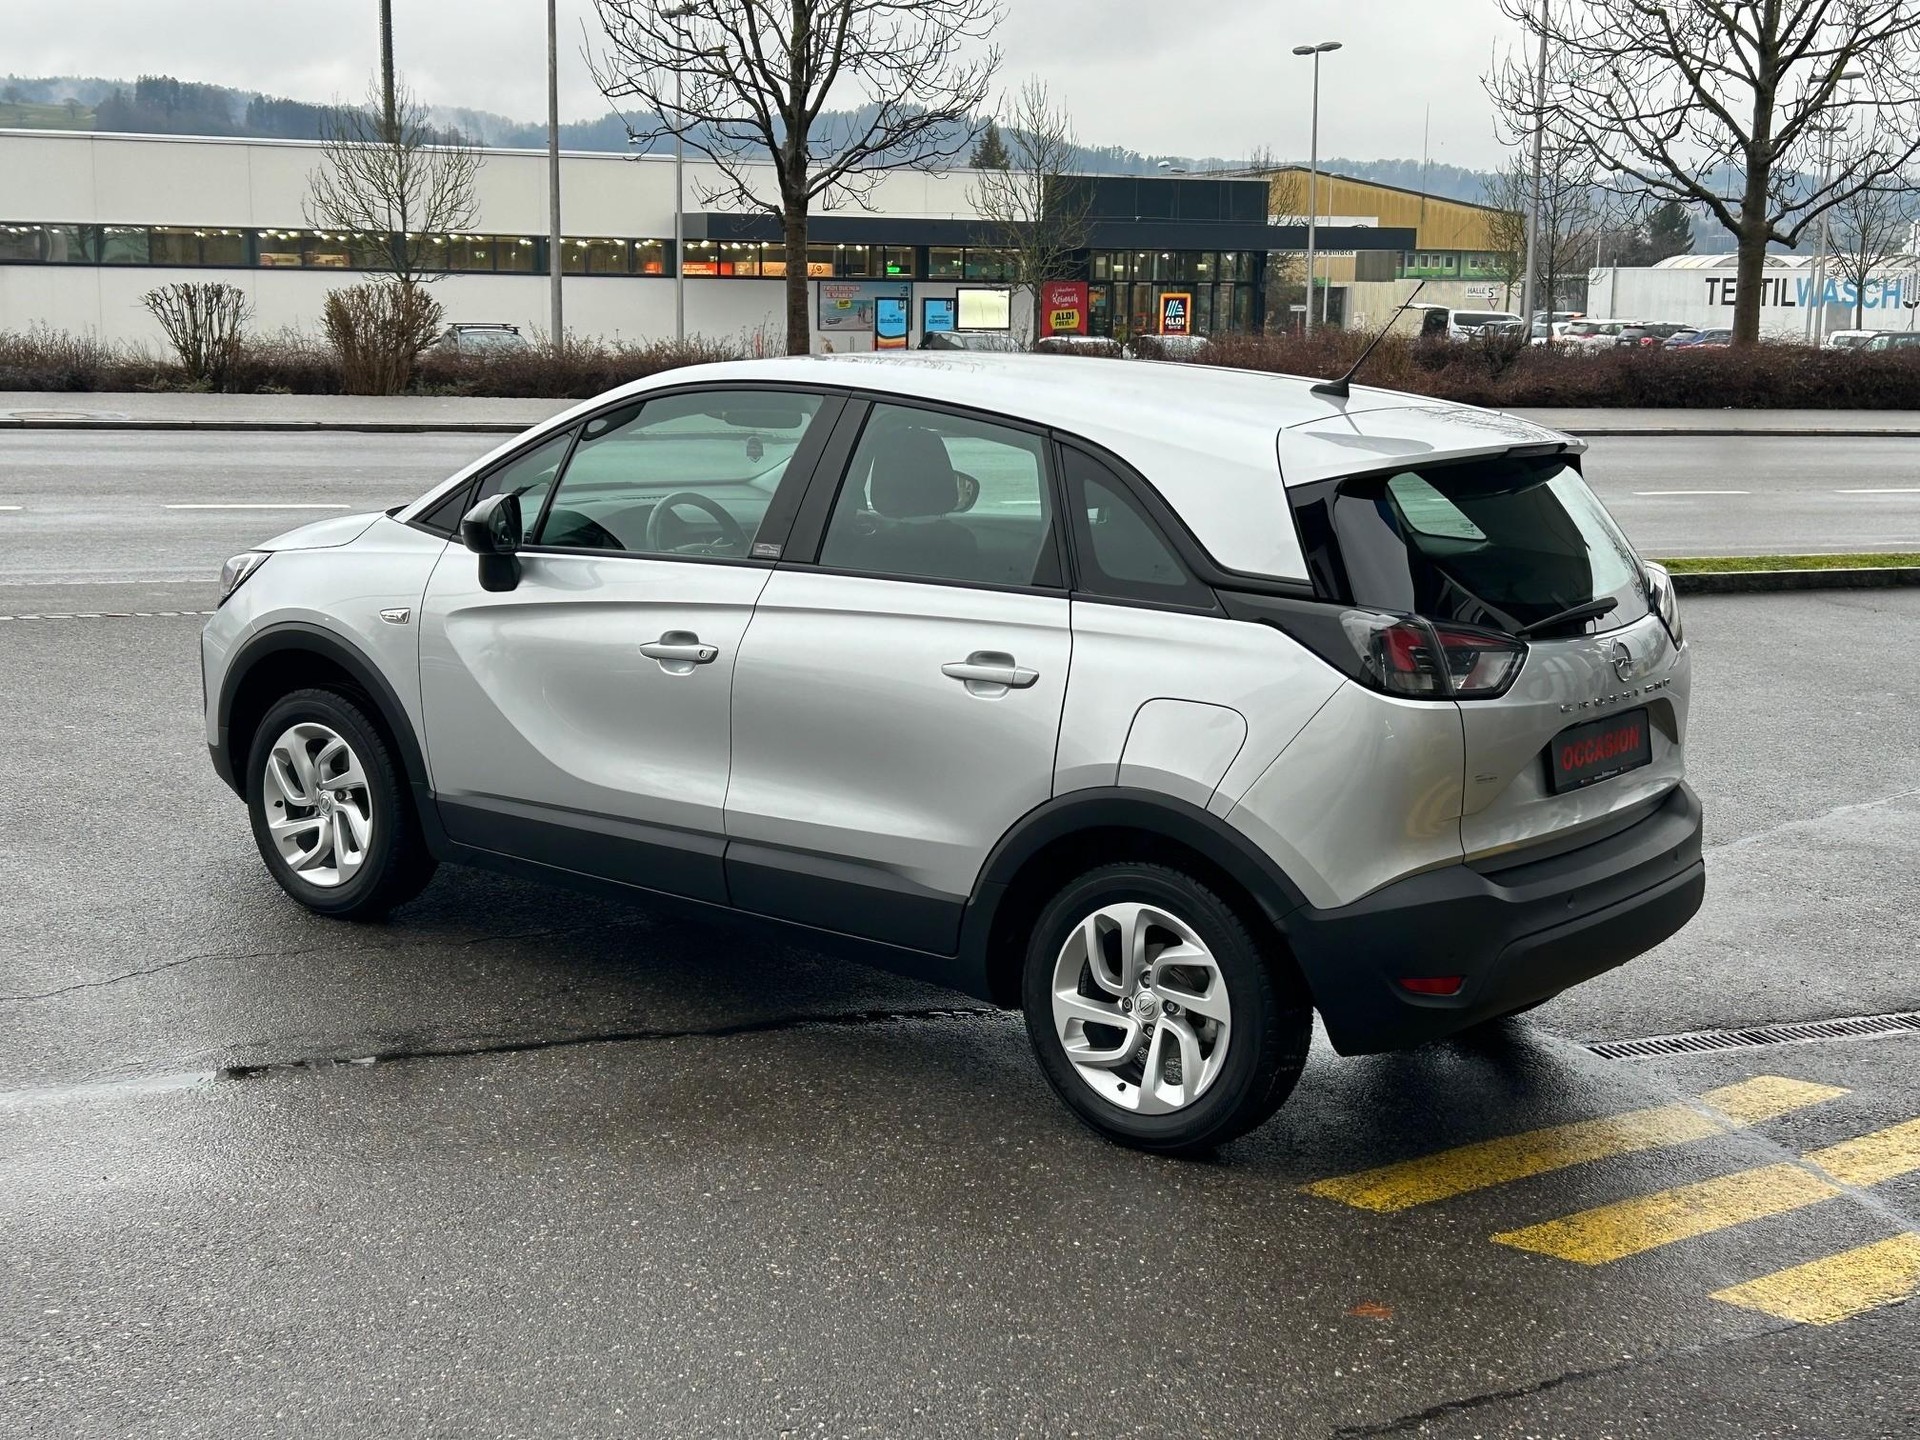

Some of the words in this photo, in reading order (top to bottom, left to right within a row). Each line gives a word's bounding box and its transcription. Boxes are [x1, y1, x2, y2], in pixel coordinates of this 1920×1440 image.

[1488, 287, 1494, 298] 5
[1705, 277, 1902, 309] TETILWASCH
[1055, 311, 1075, 320] ALDI
[1165, 317, 1185, 325] ALDI
[1561, 724, 1641, 771] OCCASION
